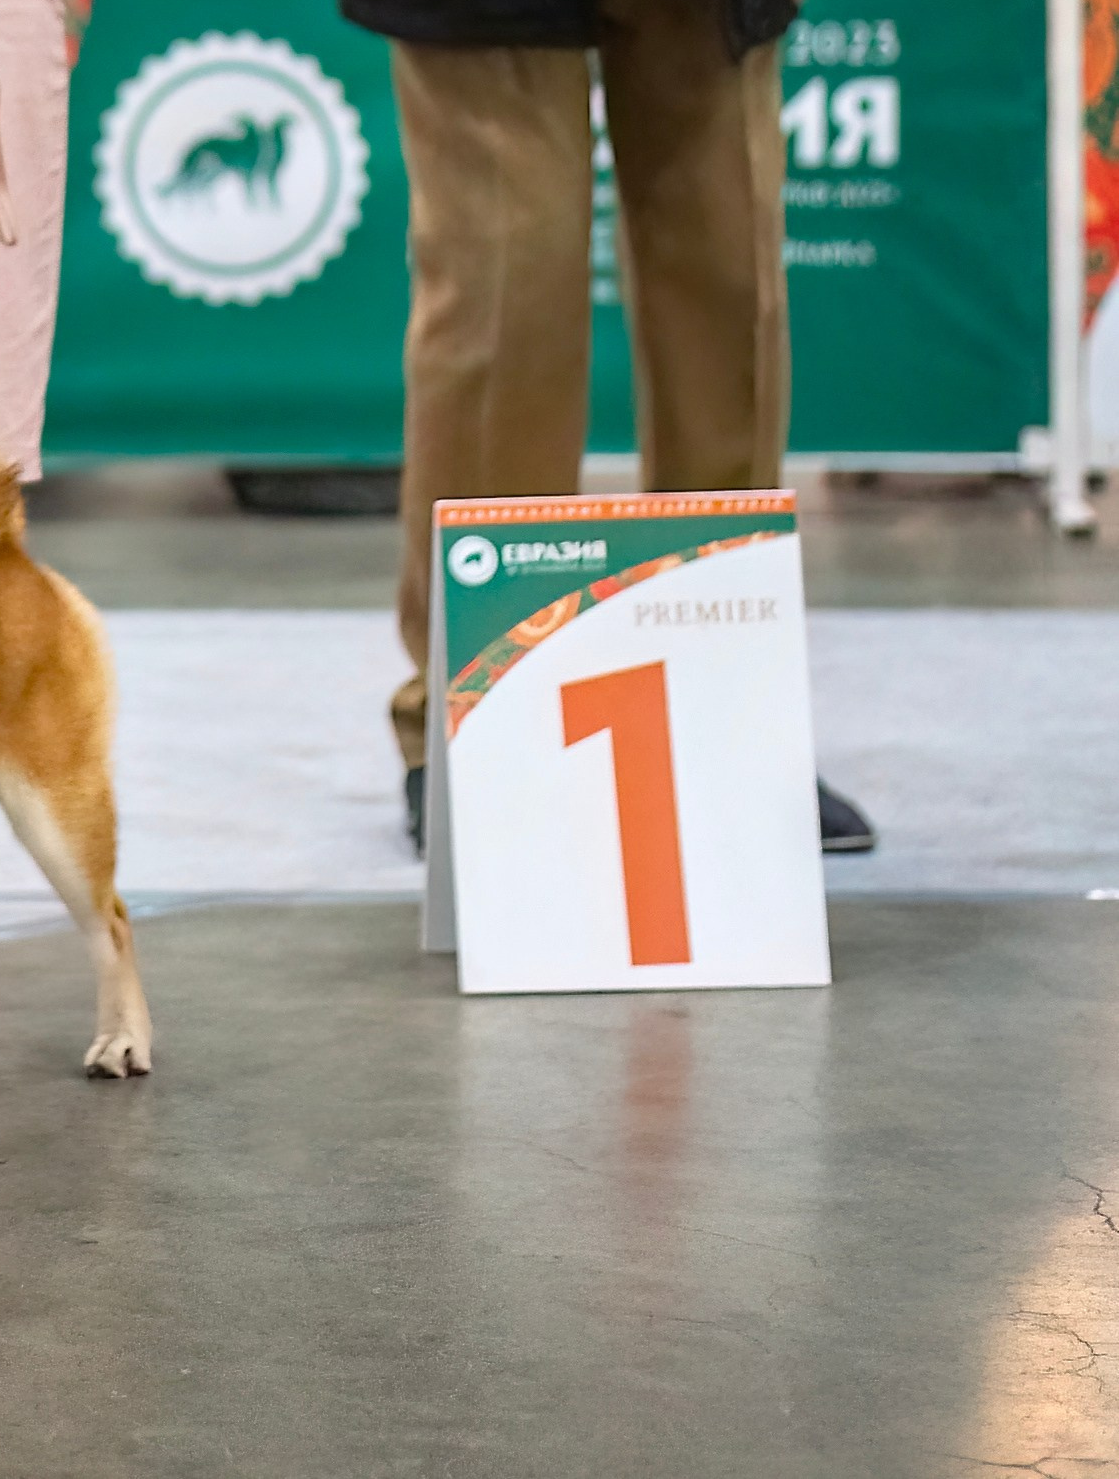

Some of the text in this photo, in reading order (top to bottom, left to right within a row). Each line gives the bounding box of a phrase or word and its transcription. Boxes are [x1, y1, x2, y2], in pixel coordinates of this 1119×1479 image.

[501, 539, 608, 566] ЕВРАЗИЯ
[634, 597, 778, 627] PREMIER
[559, 660, 692, 966] 1
